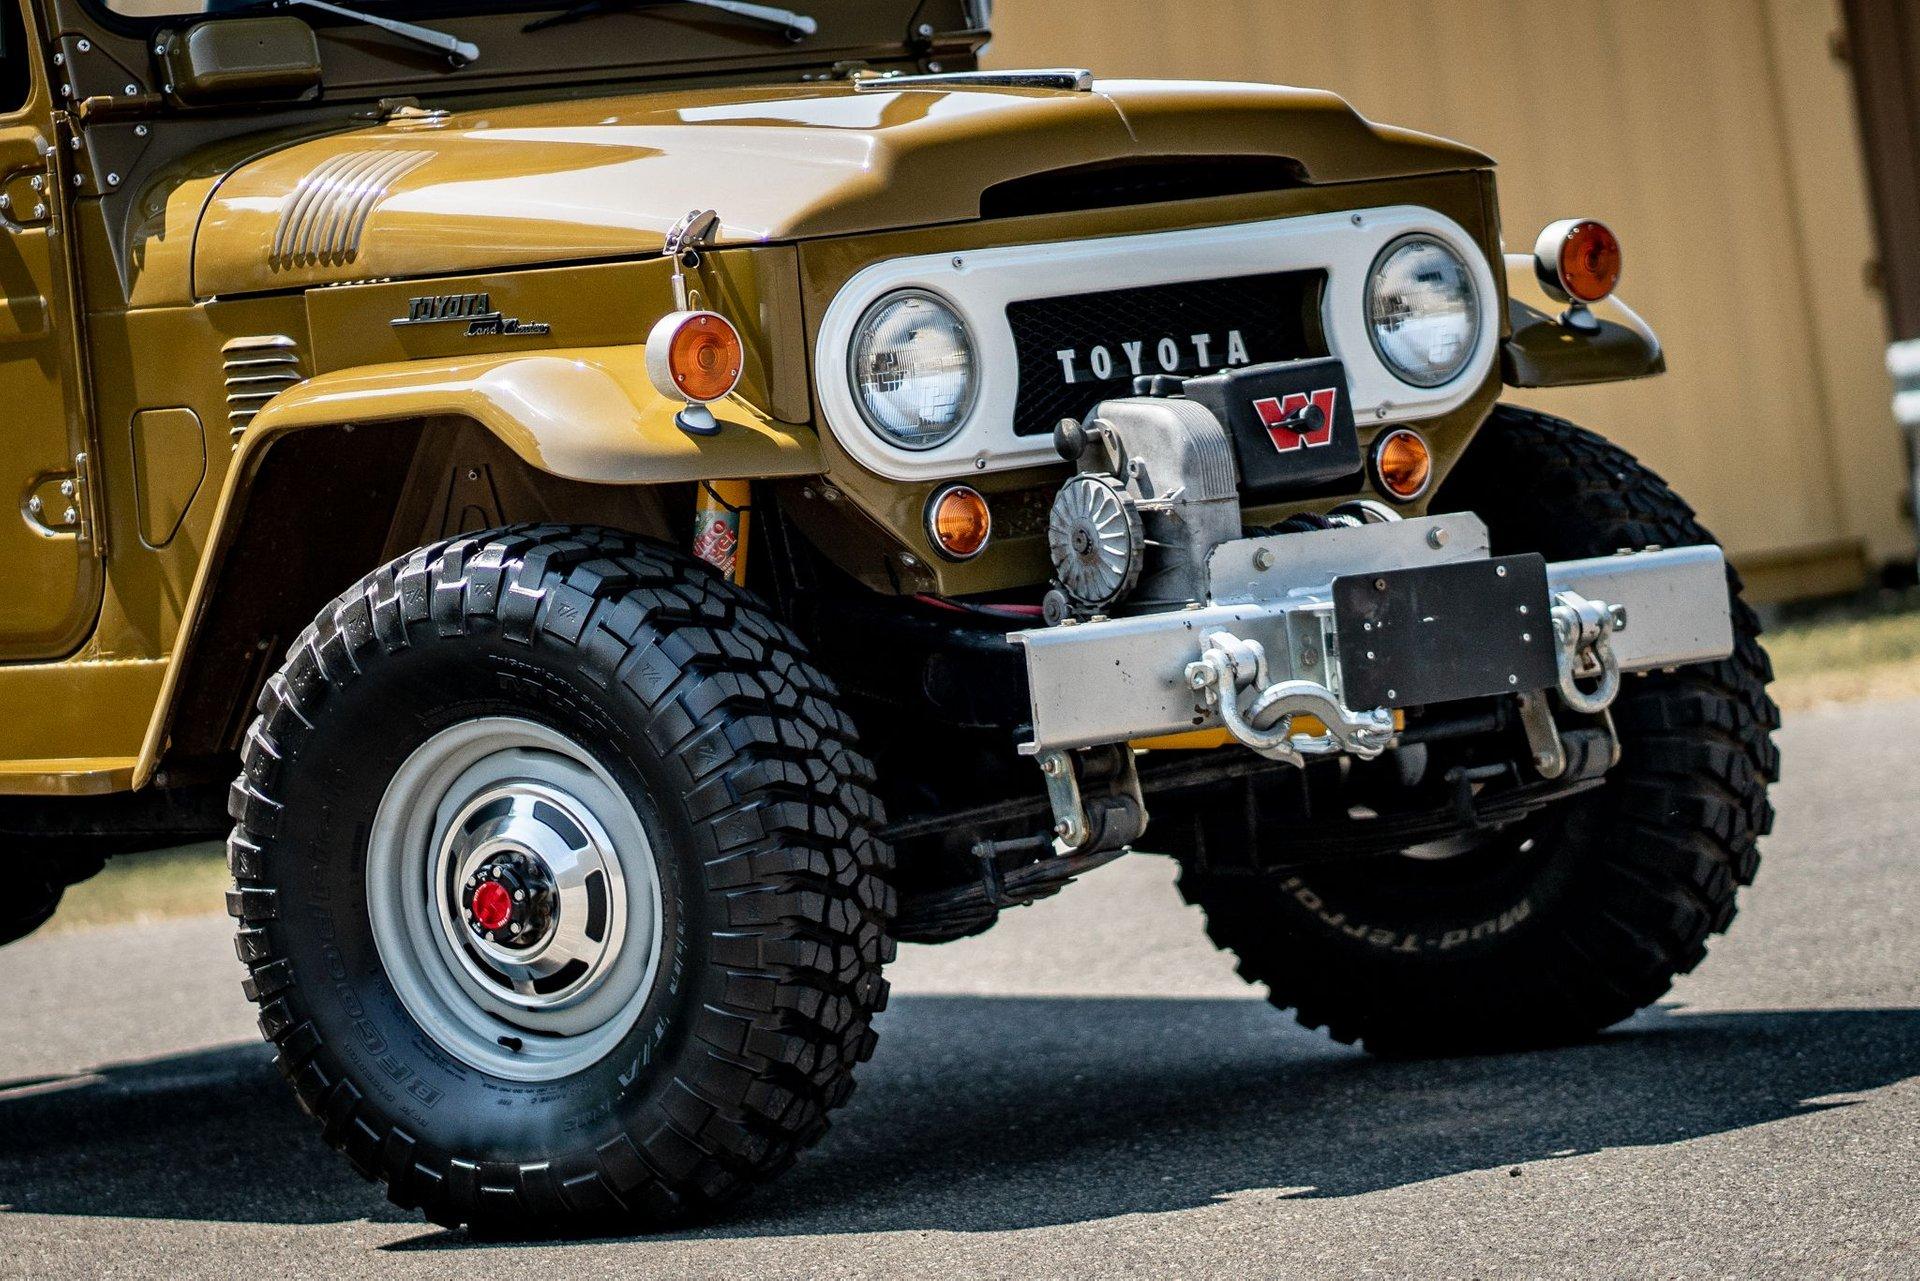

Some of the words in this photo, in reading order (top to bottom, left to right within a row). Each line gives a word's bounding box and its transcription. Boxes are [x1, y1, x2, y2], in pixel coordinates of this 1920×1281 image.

[409, 293, 489, 321] TOYOTA
[464, 319, 499, 337] Land
[1057, 329, 1250, 384] TOYOTA
[1252, 386, 1337, 454] W
[617, 1016, 672, 1088] T/A
